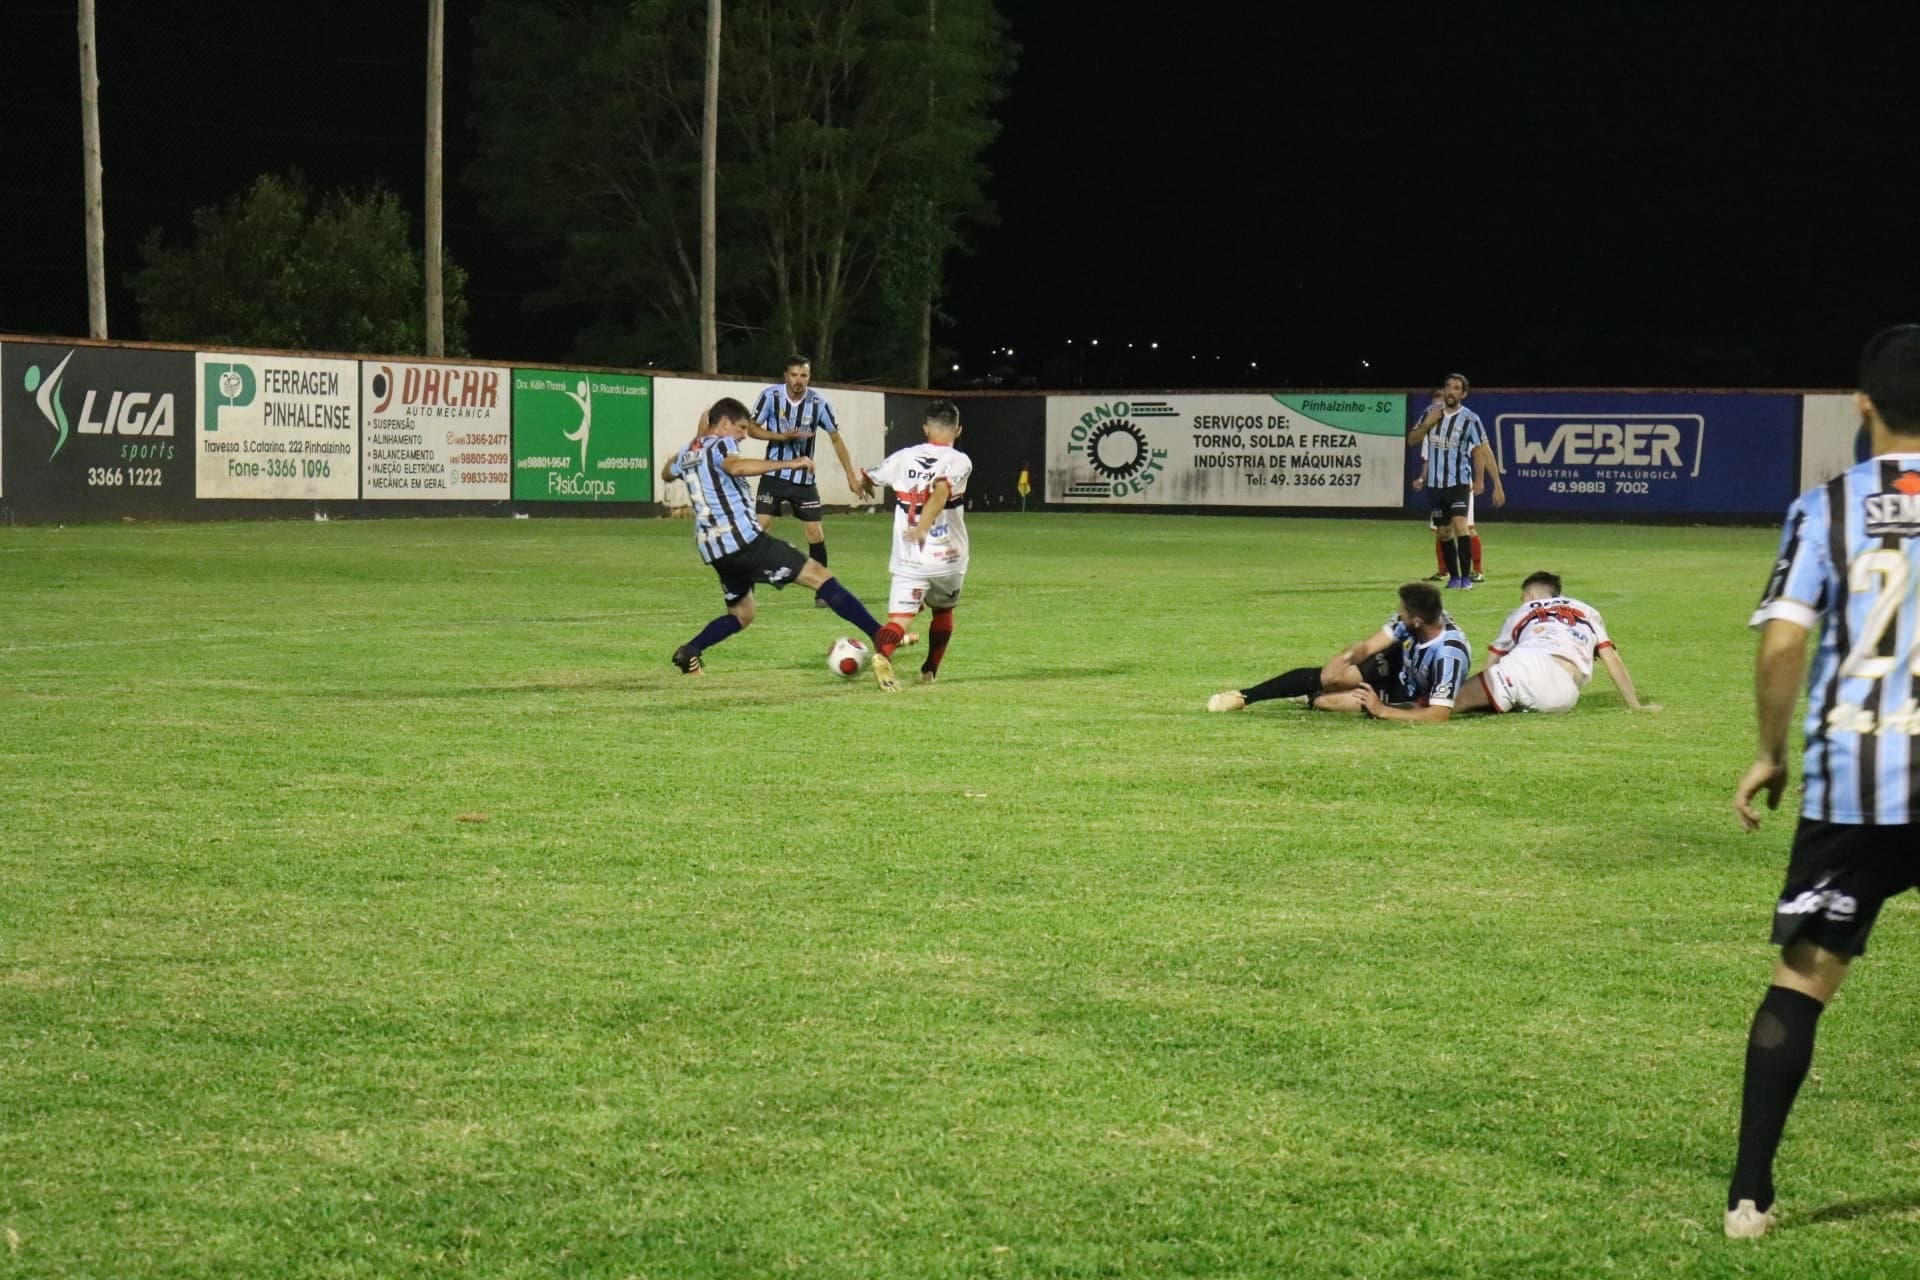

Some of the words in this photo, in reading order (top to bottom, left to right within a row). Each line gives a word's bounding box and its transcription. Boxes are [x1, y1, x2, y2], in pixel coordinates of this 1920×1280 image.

[264, 369, 338, 396] FERRAGEM
[401, 367, 498, 408] DACAR
[77, 389, 175, 437] LIGA
[406, 407, 432, 417] AUTO
[1301, 399, 1366, 413] Pinhalzinho
[1376, 401, 1392, 413] SC
[264, 402, 351, 430] PINHALENSE
[373, 417, 415, 430] SUSPENSÃO
[1193, 415, 1263, 433] SERVIÇOS
[1268, 416, 1290, 430] DE:
[1067, 401, 1130, 455] TORNO
[204, 440, 239, 453] Travessa
[289, 441, 303, 453] 222
[304, 440, 351, 455] Pinhalzinho
[373, 434, 422, 445] ALINHAMENTO
[1193, 435, 1246, 450] TORNO,
[1250, 435, 1295, 449] SOLDA
[1300, 435, 1307, 448] E
[1312, 435, 1357, 448] FREZA
[1514, 424, 1684, 467] WEBER
[121, 441, 174, 462] sports
[373, 450, 434, 461] BALANCEAMENTO
[373, 461, 401, 475] INJEÇÃO
[1194, 452, 1265, 468] INDÚSTRIA
[1269, 455, 1286, 468] DE
[1291, 451, 1362, 469] MÁQUINAS
[88, 467, 123, 486] 3366
[127, 467, 162, 486] 1222
[301, 459, 330, 478] 1096
[1112, 447, 1168, 498] OESTE
[1518, 468, 1580, 479] INDÚSTRIA
[1597, 469, 1678, 480] METALÚRGICA
[373, 476, 408, 488] MECÂNICA
[411, 478, 421, 488] EM
[424, 478, 446, 489] GERAL
[1245, 474, 1266, 486] Tel:
[1270, 474, 1289, 486] 49.
[1294, 474, 1325, 487] 3366
[1329, 474, 1361, 487] 2637
[1616, 482, 1649, 494] 7002
